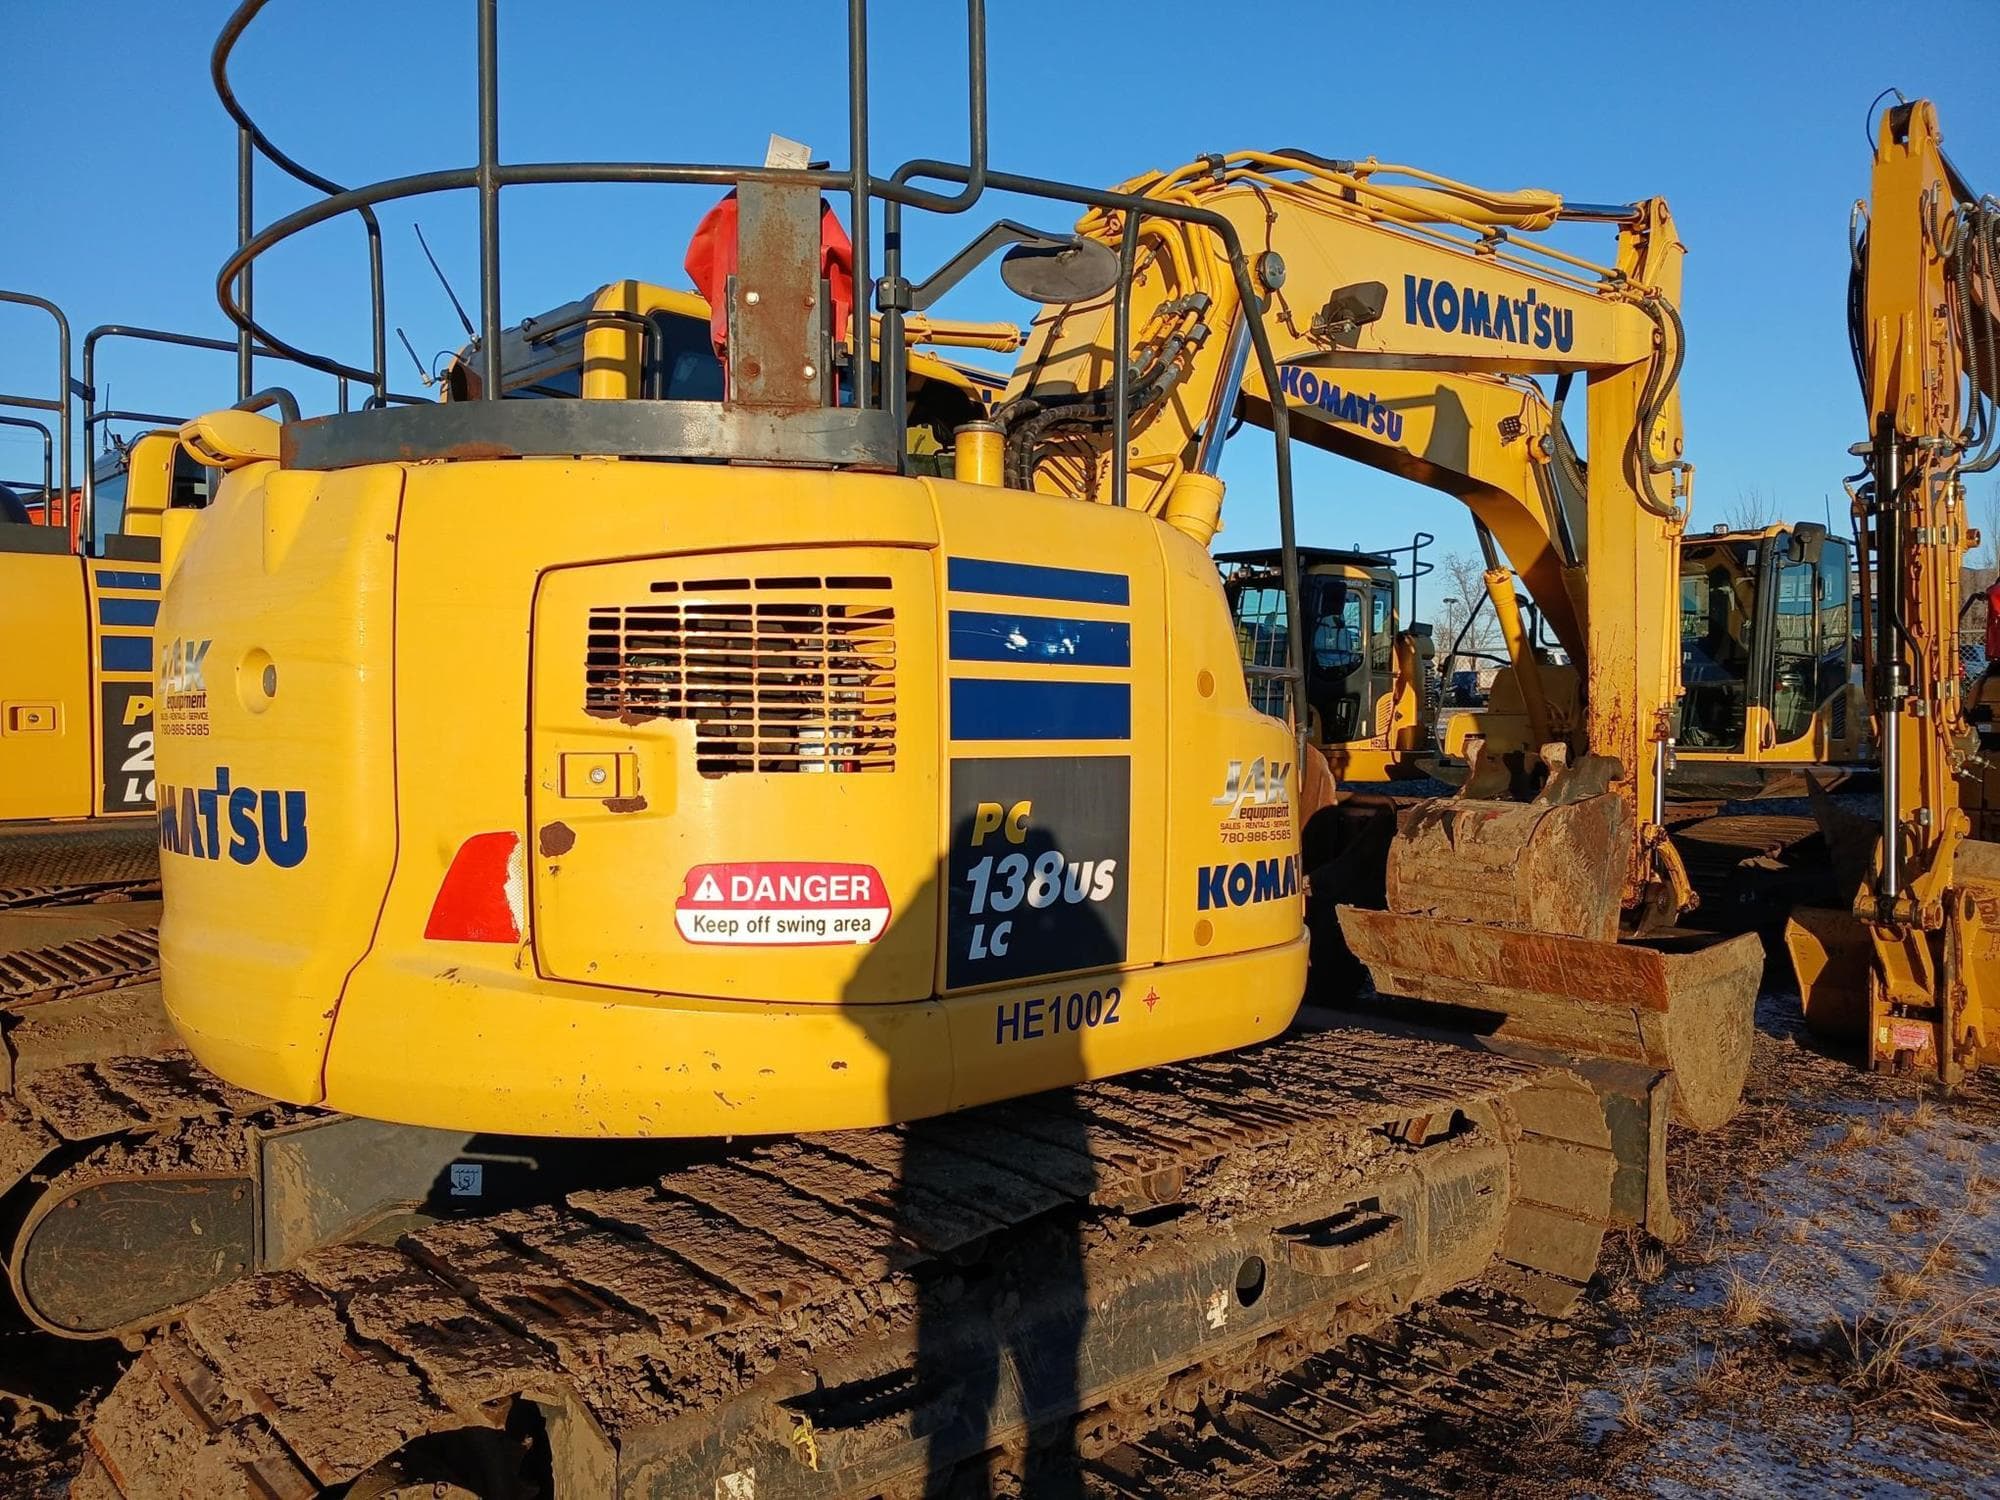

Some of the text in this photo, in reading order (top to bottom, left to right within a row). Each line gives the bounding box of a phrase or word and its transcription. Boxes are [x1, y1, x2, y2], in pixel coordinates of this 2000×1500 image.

[1404, 274, 1573, 353] KOMATSU
[1280, 366, 1403, 442] KOMATSU
[123, 696, 153, 725] P
[121, 731, 154, 771] 2
[1212, 755, 1291, 820] JAK
[159, 767, 308, 868] MATSU
[971, 800, 1032, 846] PC
[1240, 805, 1289, 821] equipment
[1245, 821, 1271, 830] RENTALS
[1220, 830, 1291, 844] 780-986-5585
[731, 875, 871, 902] DANGER
[694, 914, 871, 936] Keep off swing area
[968, 920, 1013, 960] LC
[996, 987, 1121, 1045] HE1002
